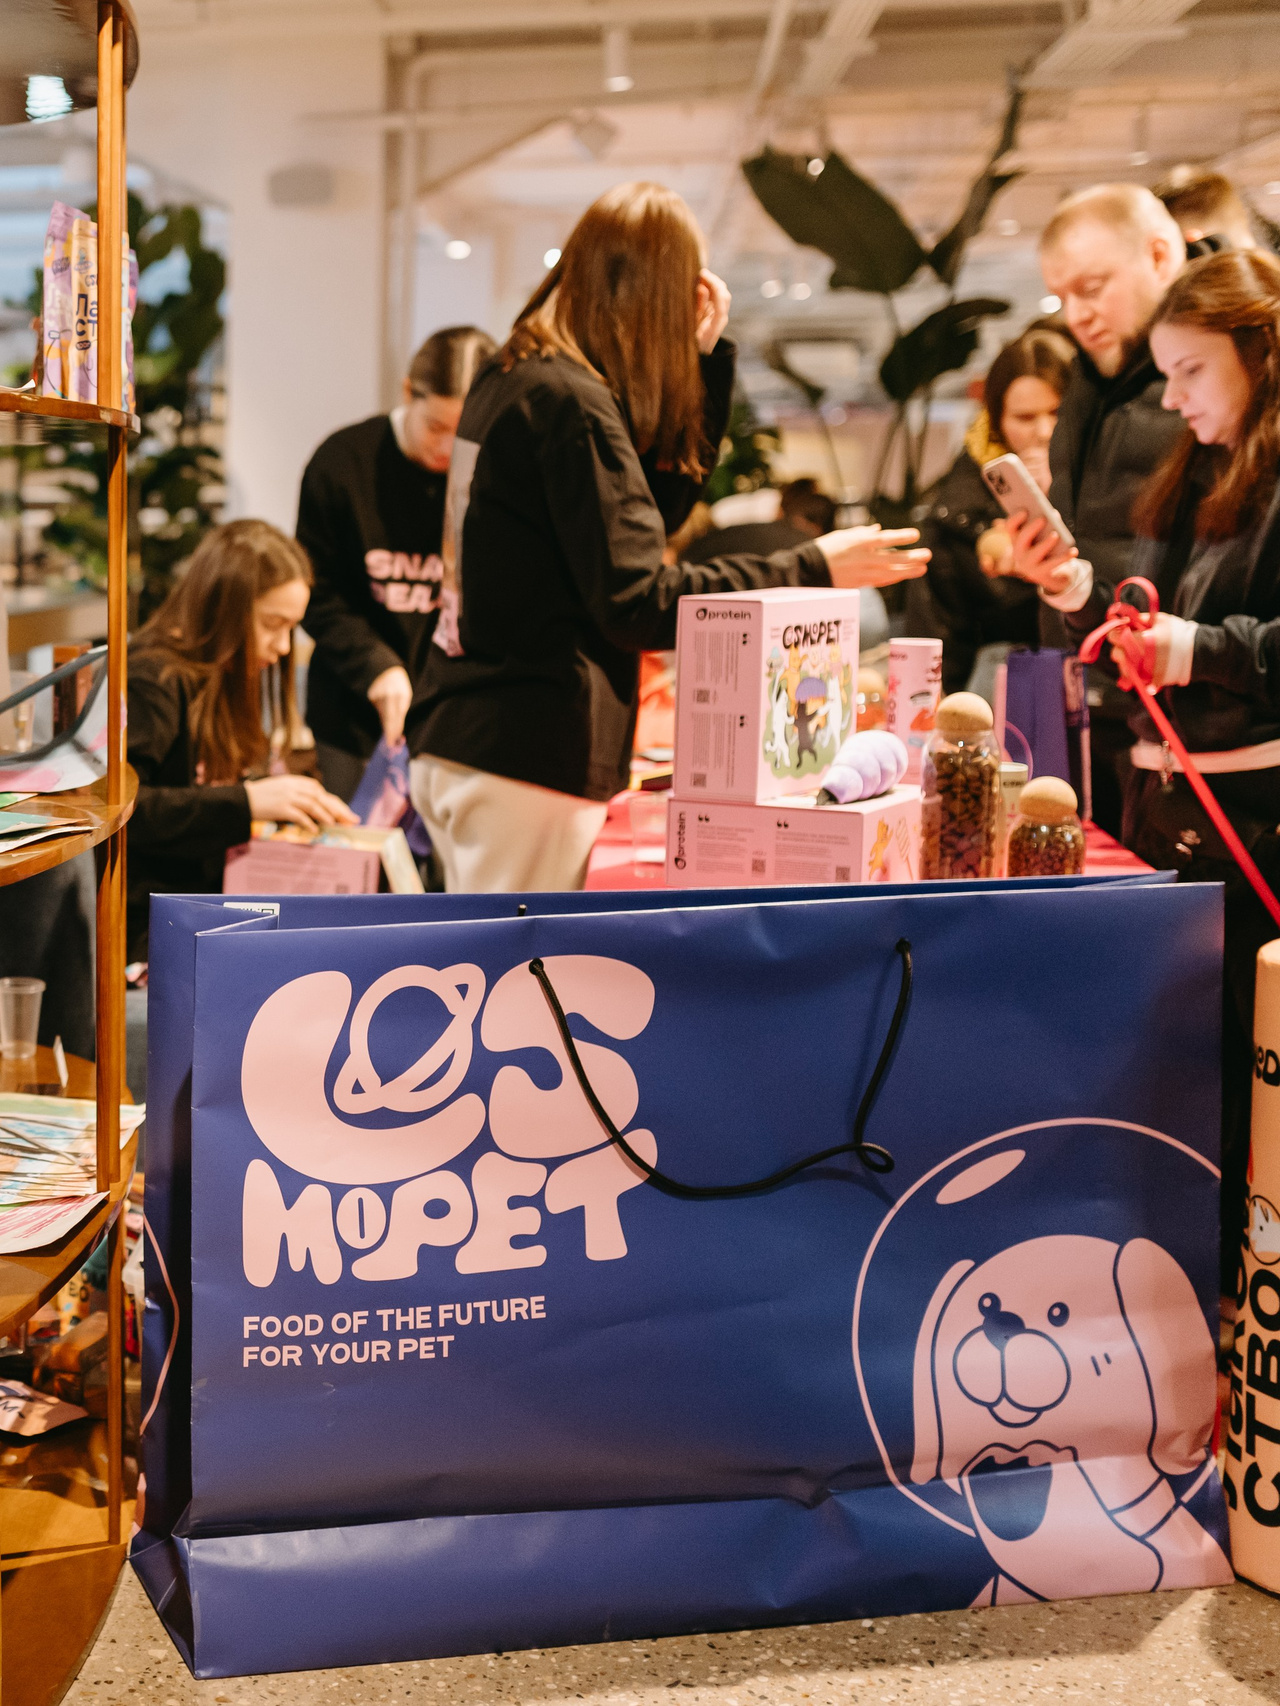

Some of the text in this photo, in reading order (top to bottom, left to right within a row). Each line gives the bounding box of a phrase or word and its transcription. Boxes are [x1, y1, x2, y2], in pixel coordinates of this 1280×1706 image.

[365, 548, 444, 582] SNA
[241, 1127, 658, 1288] MOPET
[242, 1295, 546, 1339] FOOD OF THE FUTURE
[242, 1334, 455, 1368] FOR YOUR PET
